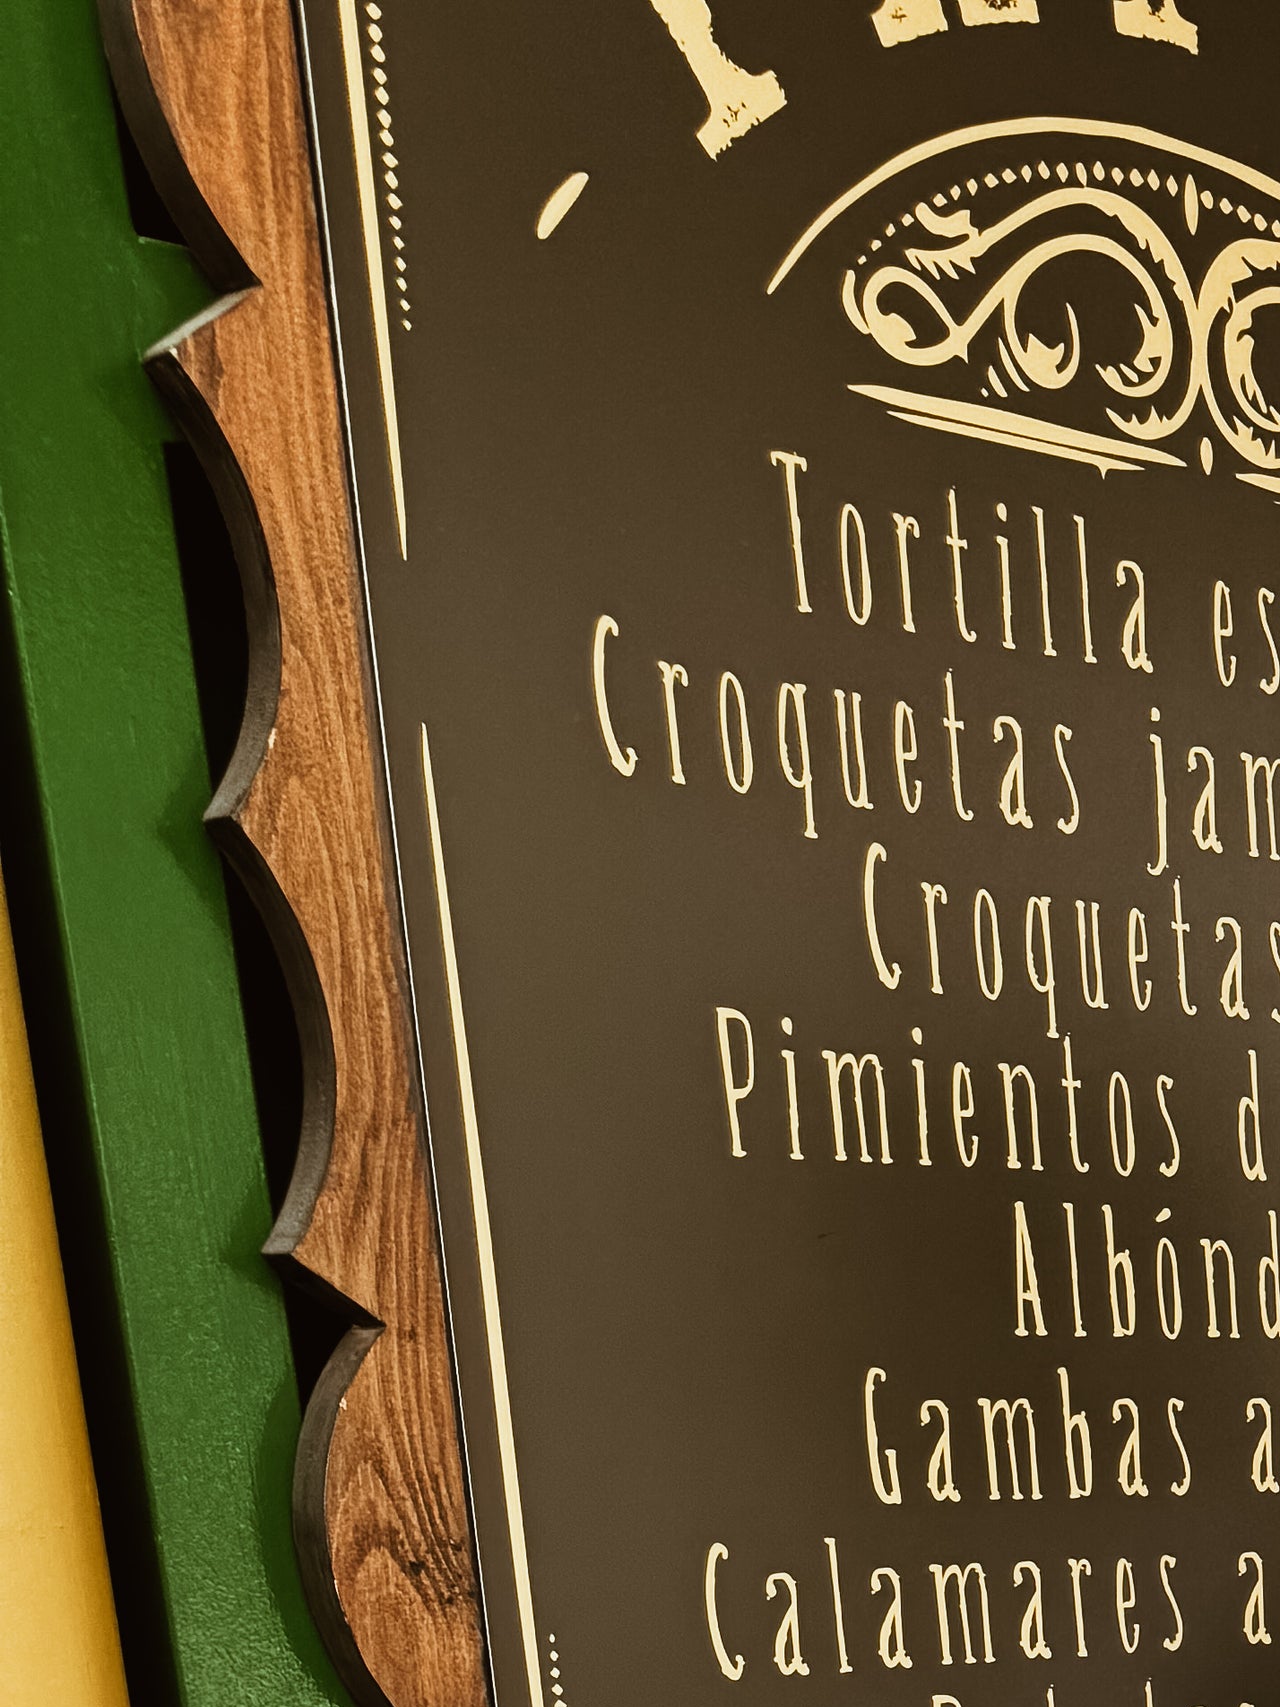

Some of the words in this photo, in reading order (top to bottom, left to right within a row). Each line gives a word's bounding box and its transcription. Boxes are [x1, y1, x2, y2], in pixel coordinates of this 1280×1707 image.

[770, 450, 1154, 675] Tortilla
[592, 614, 1080, 840] Croquetas
[715, 1006, 1181, 1178] Pimientos
[863, 1366, 1191, 1505] Gambas
[704, 1537, 1184, 1681] Calamares
[1238, 1551, 1272, 1645] a
